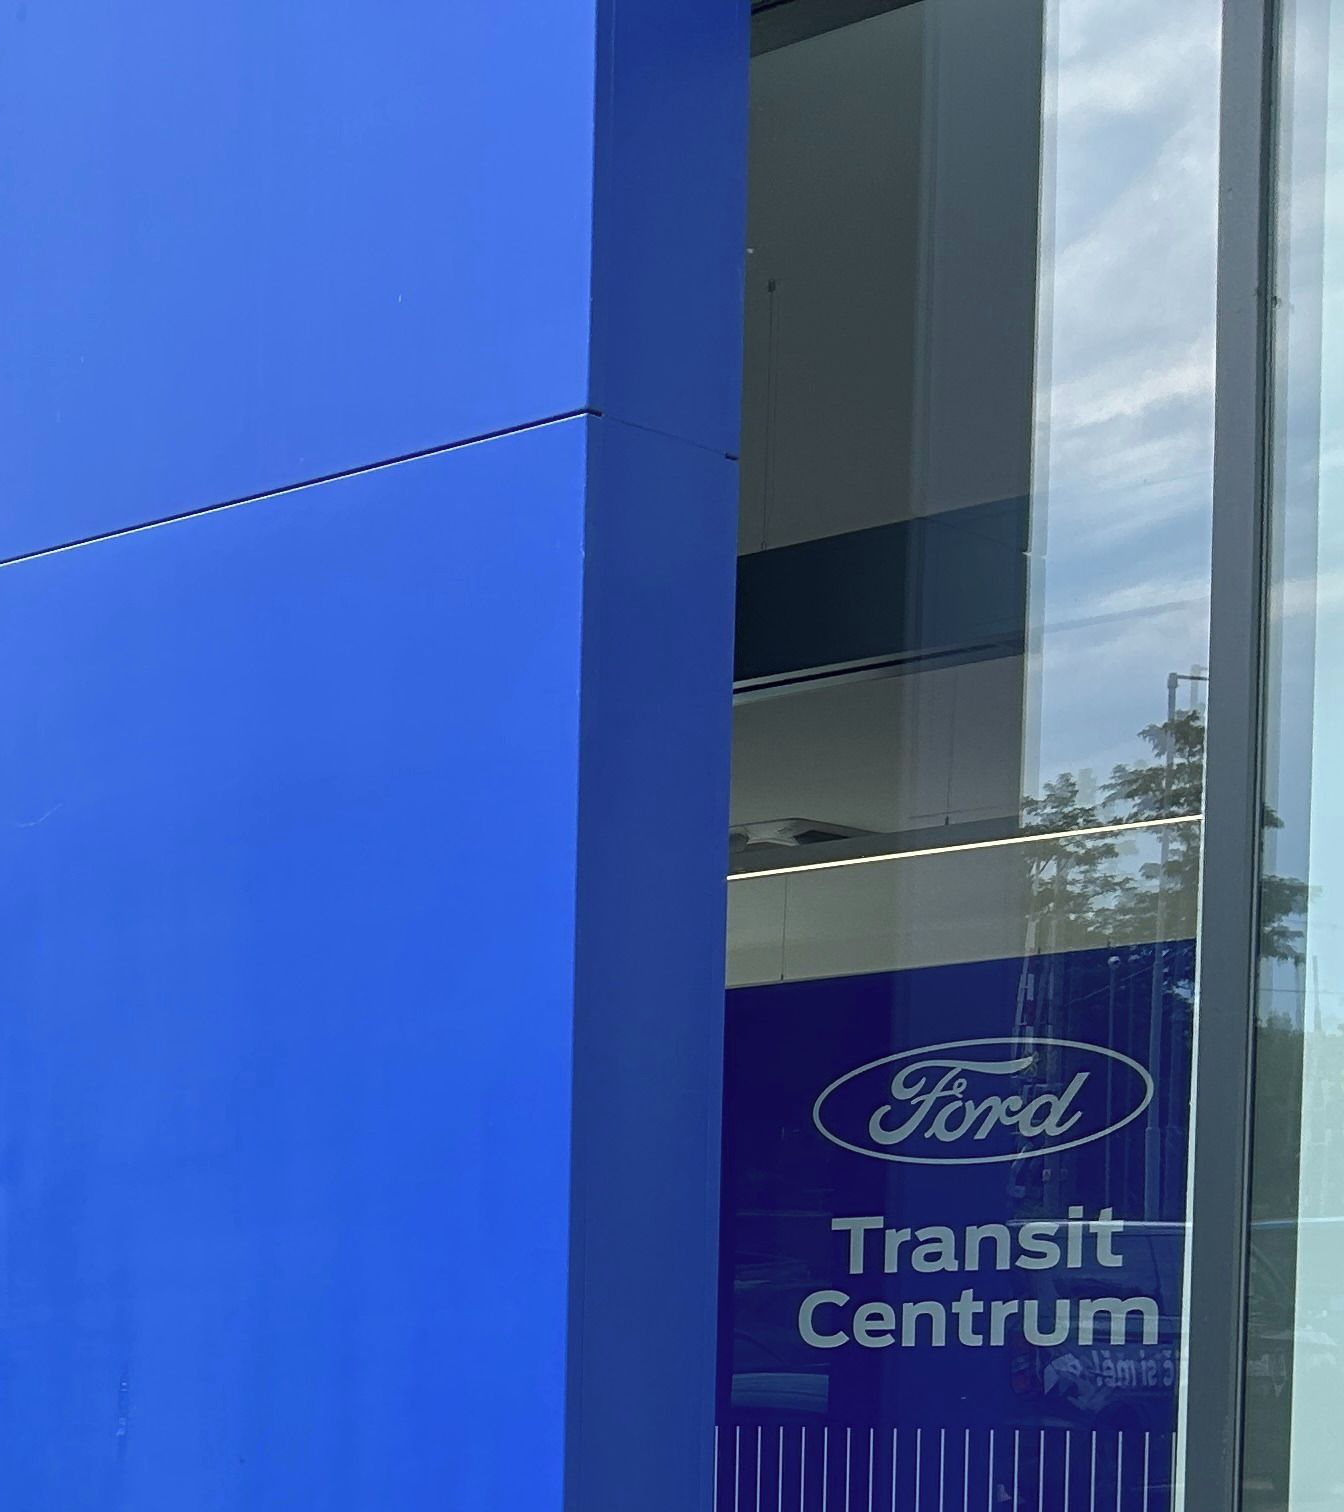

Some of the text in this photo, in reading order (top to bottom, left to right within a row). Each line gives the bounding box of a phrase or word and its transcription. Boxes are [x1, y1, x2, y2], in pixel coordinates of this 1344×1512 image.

[868, 1056, 1091, 1145] Ford
[831, 1205, 1124, 1275] Transit
[797, 1288, 1160, 1349] Centrum
